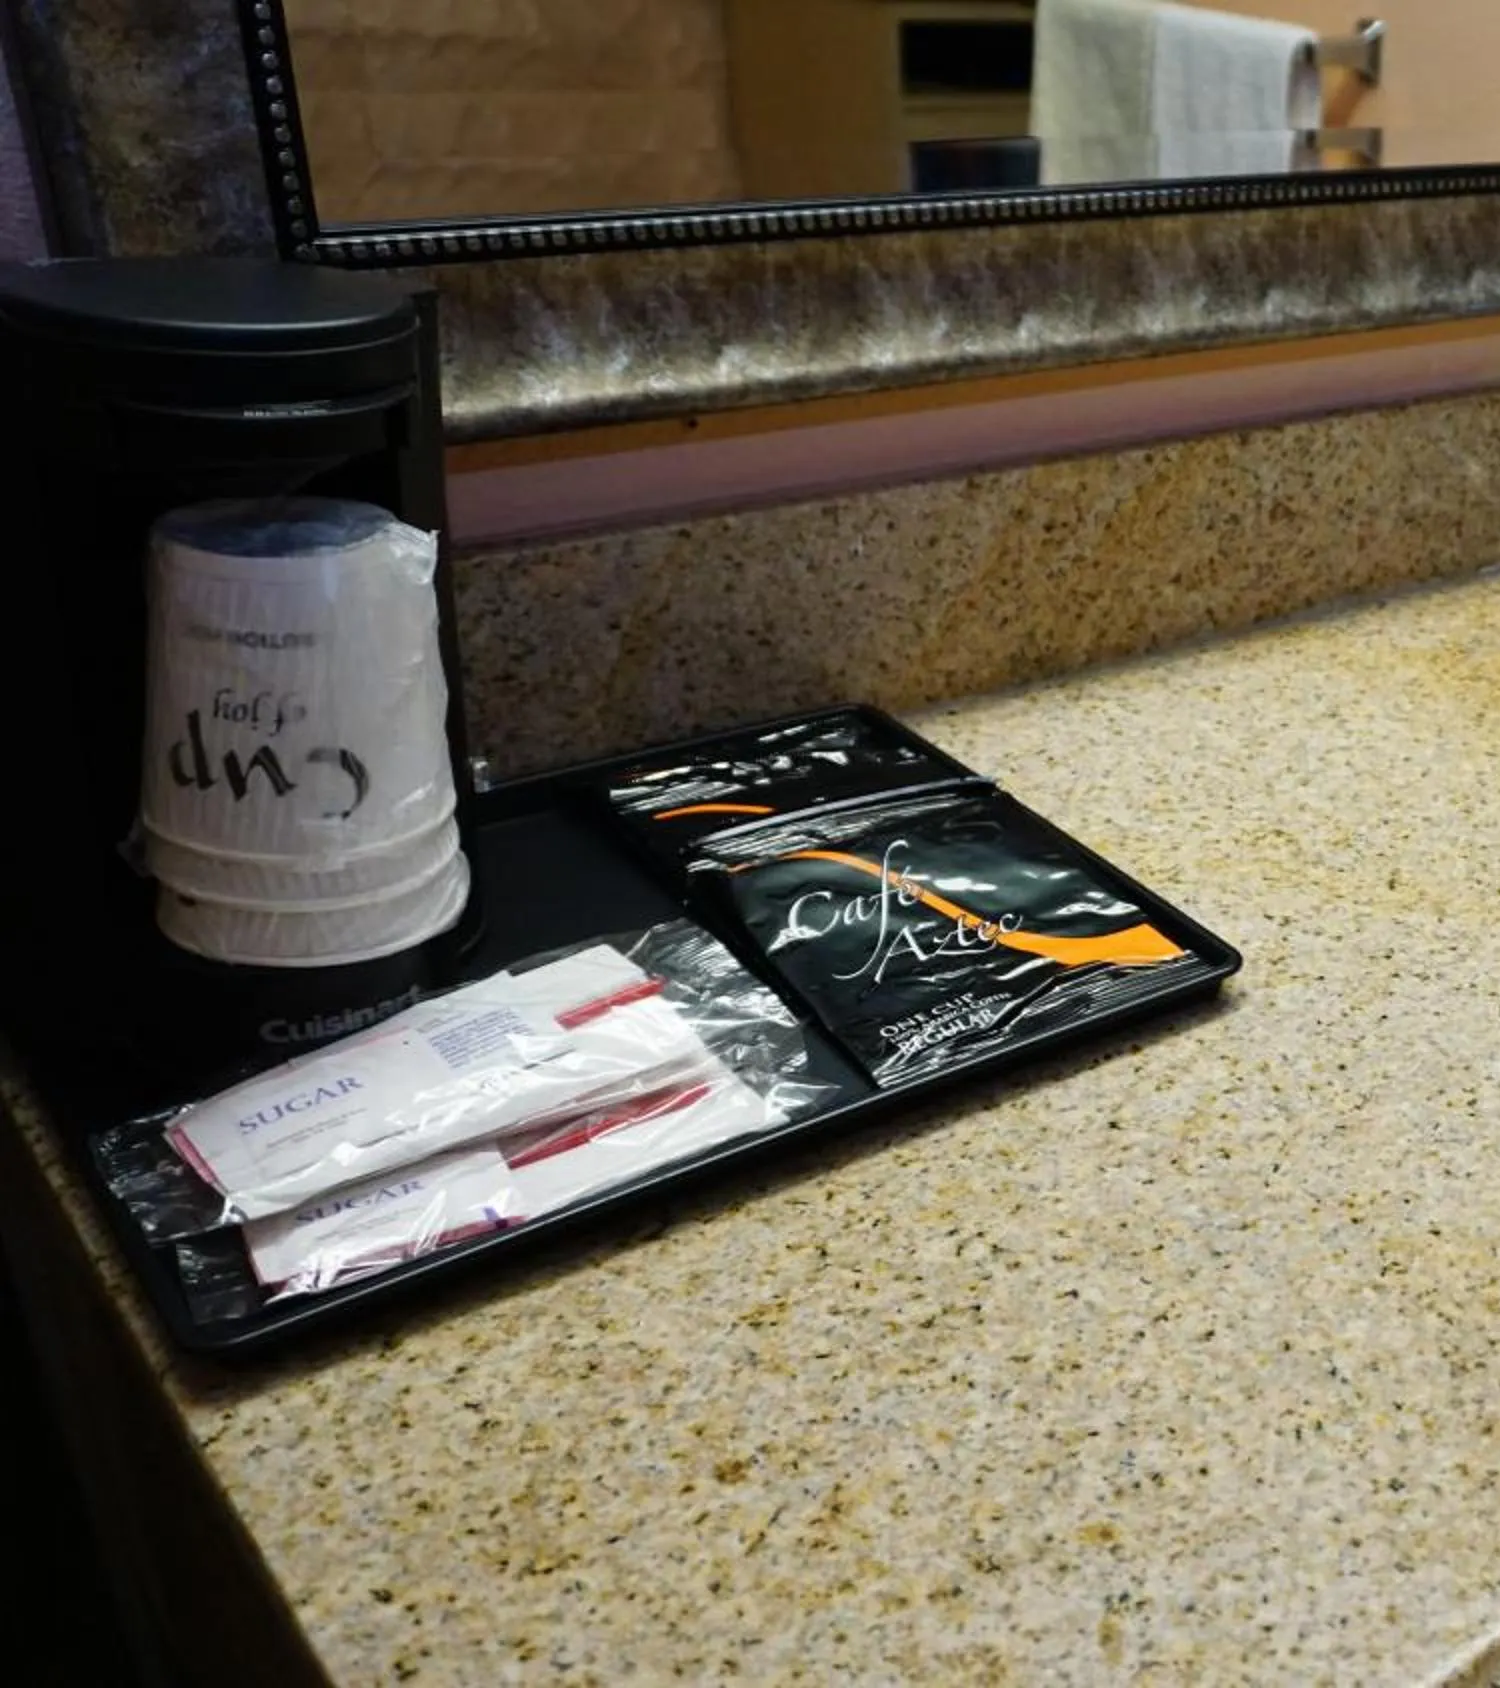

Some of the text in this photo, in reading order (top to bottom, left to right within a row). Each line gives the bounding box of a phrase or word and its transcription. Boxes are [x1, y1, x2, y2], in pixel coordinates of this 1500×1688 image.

[213, 687, 274, 731] joy
[168, 708, 370, 820] Cup
[788, 839, 918, 980] Café
[873, 913, 1024, 984] Aztec
[259, 984, 422, 1044] Cuisinart
[879, 1012, 929, 1038] ONE
[238, 1076, 365, 1136] SUGAR
